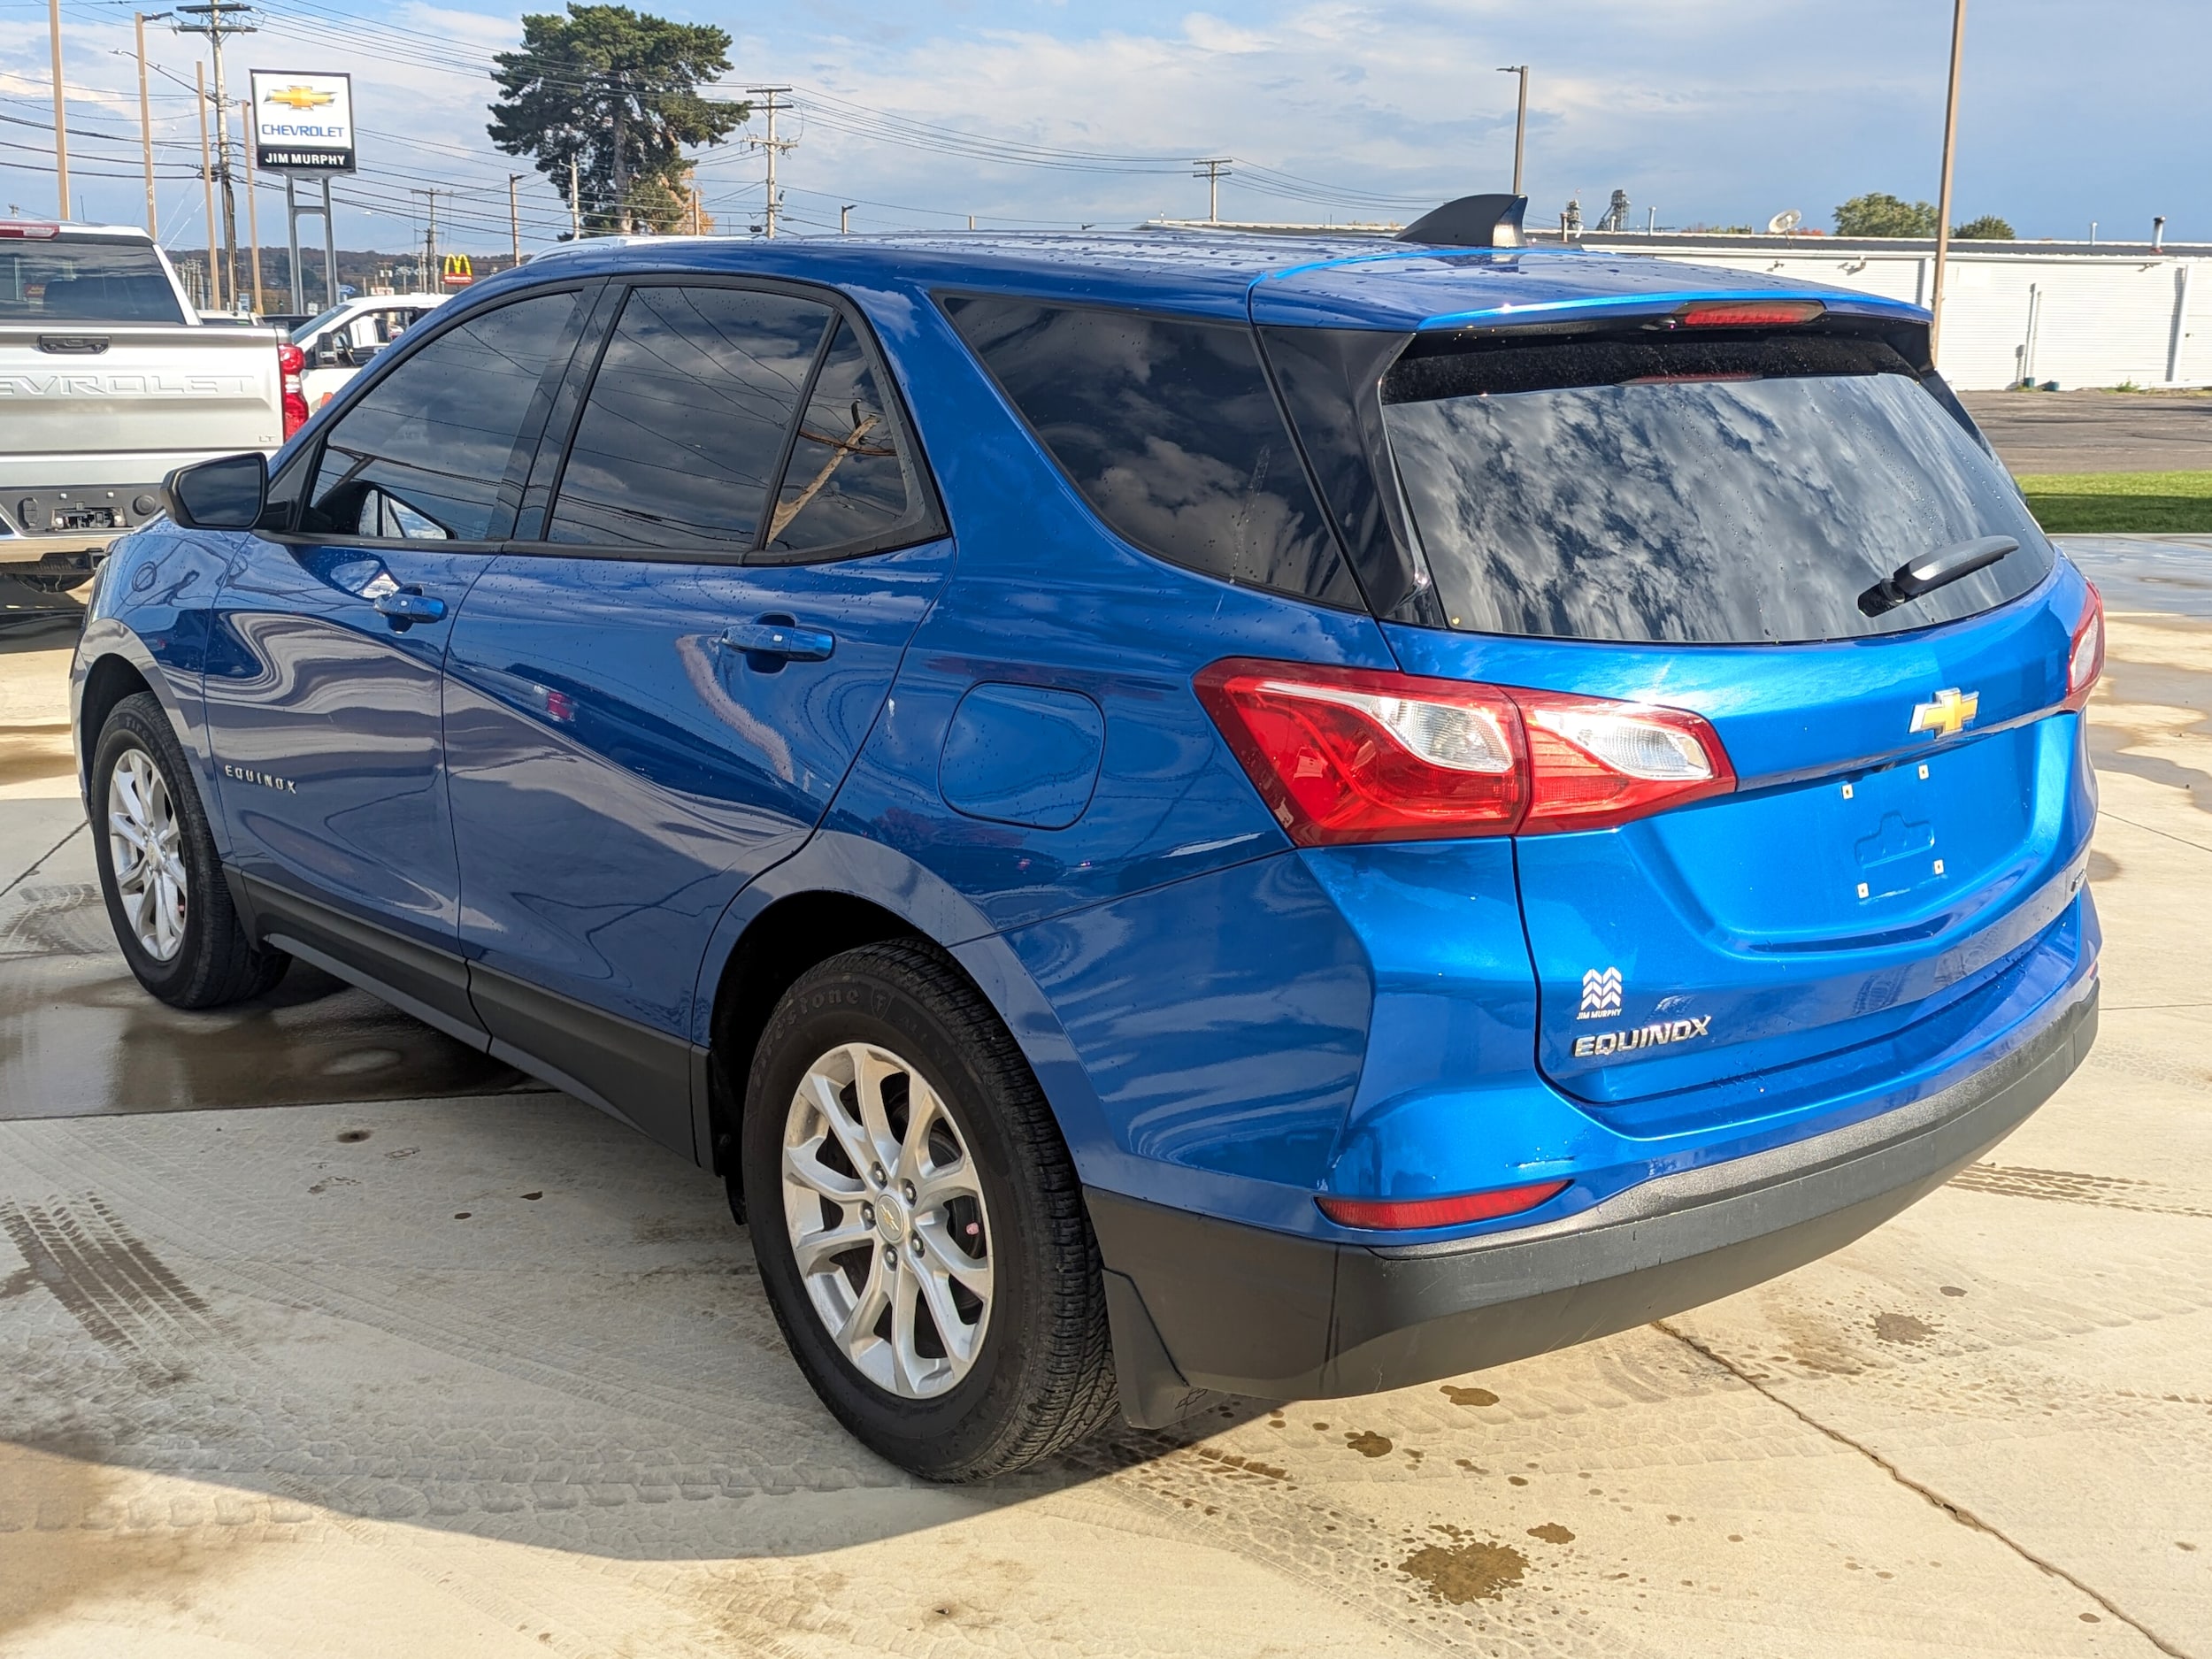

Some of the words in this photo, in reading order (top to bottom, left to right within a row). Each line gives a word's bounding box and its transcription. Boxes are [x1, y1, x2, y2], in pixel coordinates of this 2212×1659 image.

[261, 124, 345, 138] CHEVROLET
[265, 152, 288, 164] JIM
[290, 153, 345, 165] MURPHY
[225, 764, 297, 795] EQUINOX
[1576, 1011, 1591, 1020] JIM
[1591, 1008, 1622, 1019] MURPHY
[1573, 1015, 1712, 1058] EQUINOX
